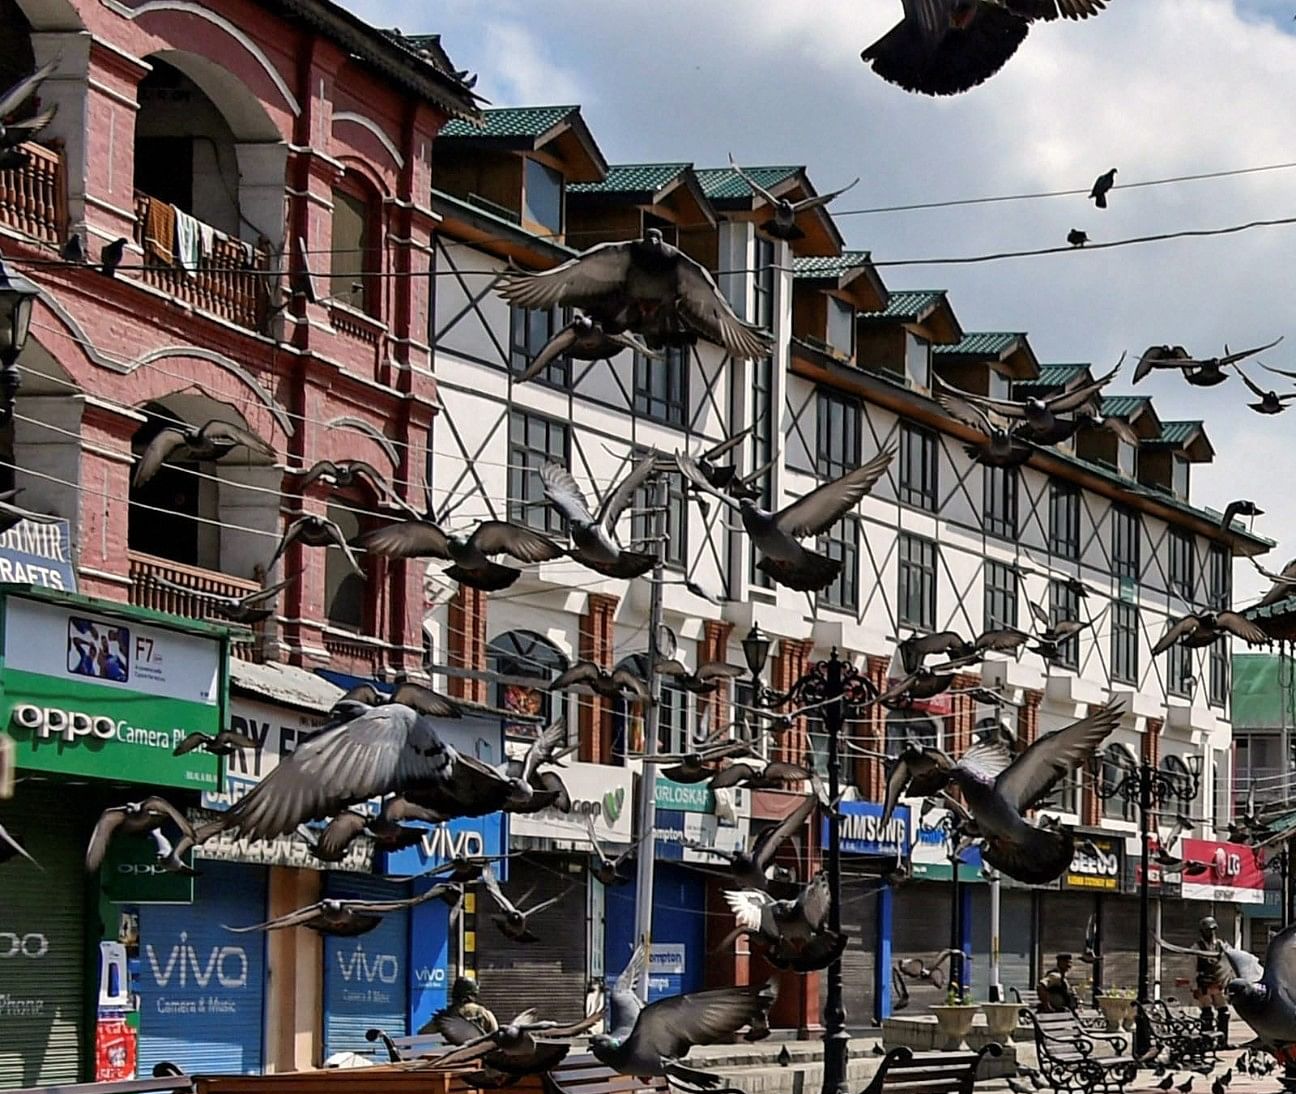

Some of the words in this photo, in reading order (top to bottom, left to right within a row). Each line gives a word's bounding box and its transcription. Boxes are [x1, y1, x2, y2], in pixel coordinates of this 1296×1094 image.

[136, 636, 154, 663] F7
[117, 720, 169, 750] Camera
[421, 822, 484, 859] vivo
[1227, 853, 1240, 876] LG
[146, 931, 248, 989] vivo
[337, 943, 399, 984] vivo
[415, 966, 445, 982] vivo
[156, 997, 197, 1014] Camera
[208, 997, 237, 1013] Music
